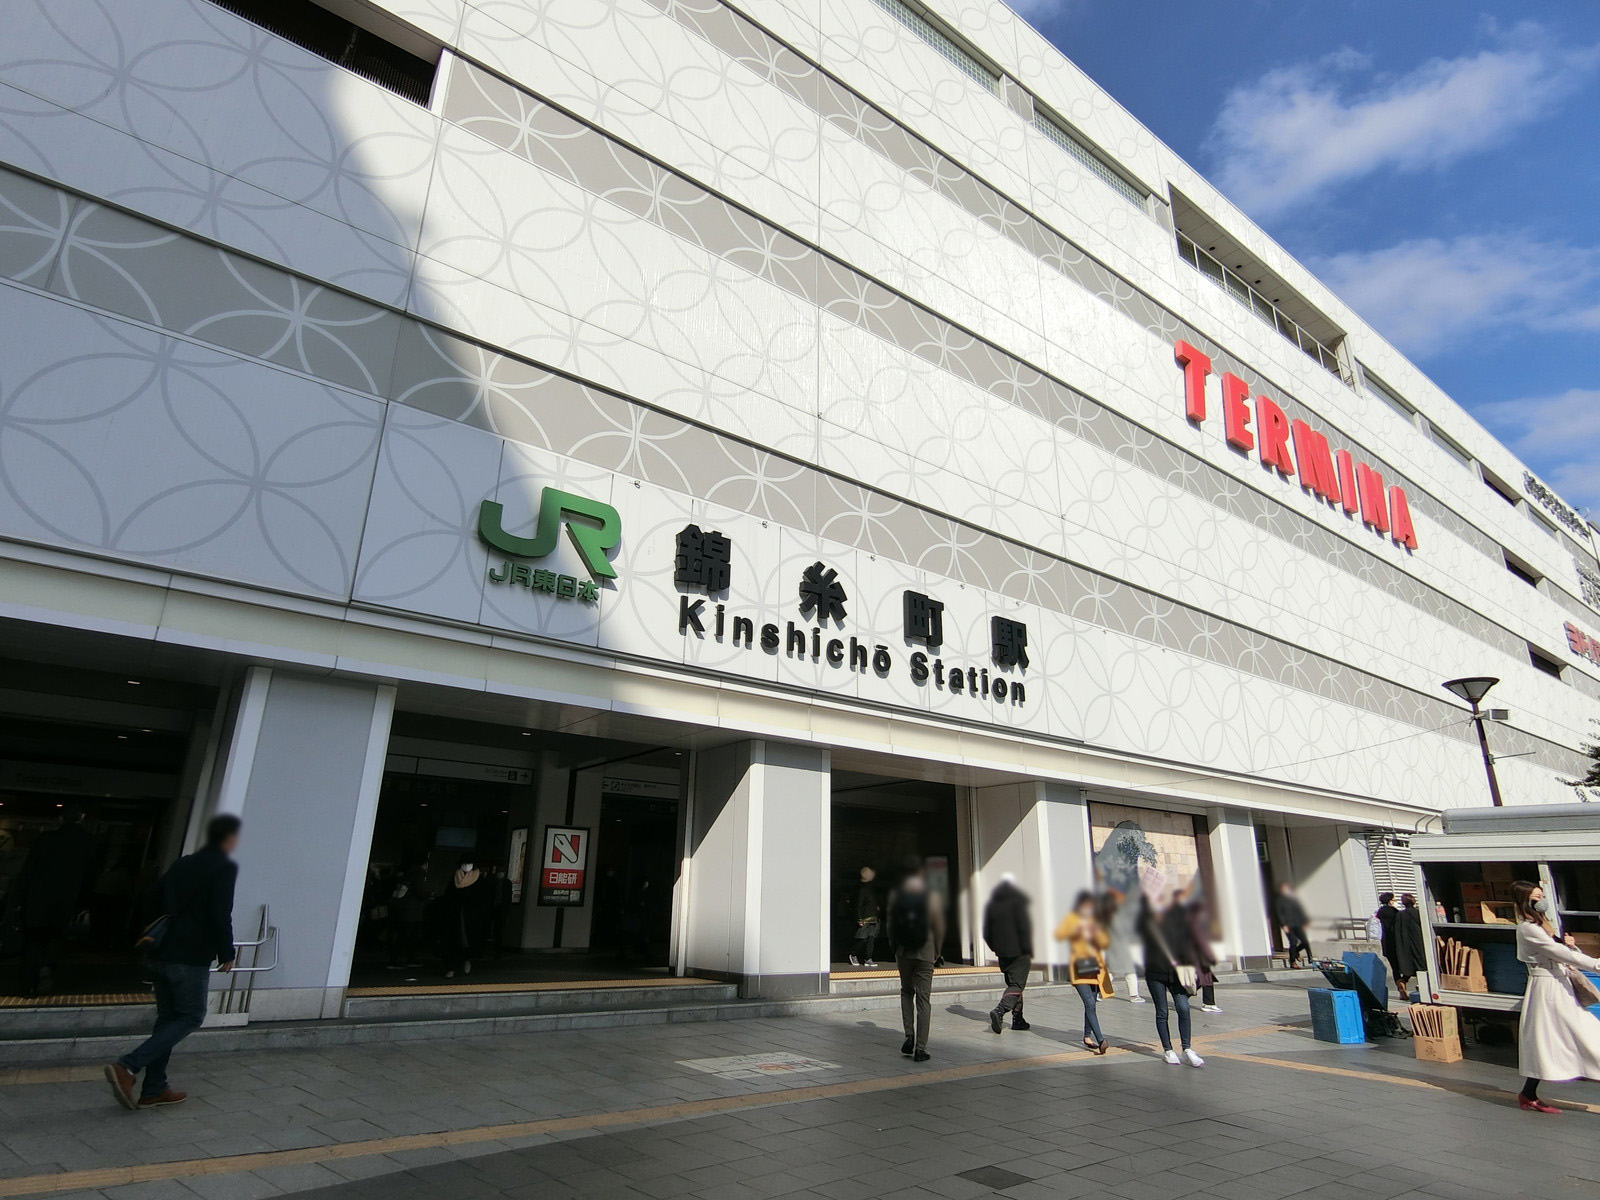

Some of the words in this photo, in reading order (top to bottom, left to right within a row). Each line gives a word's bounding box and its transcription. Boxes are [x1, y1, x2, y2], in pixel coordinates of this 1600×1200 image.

[1174, 339, 1419, 550] TERMINA
[478, 486, 622, 579] JR
[489, 561, 600, 601] JR東日本
[910, 651, 1026, 702] Station
[549, 871, 578, 885] 日能研
